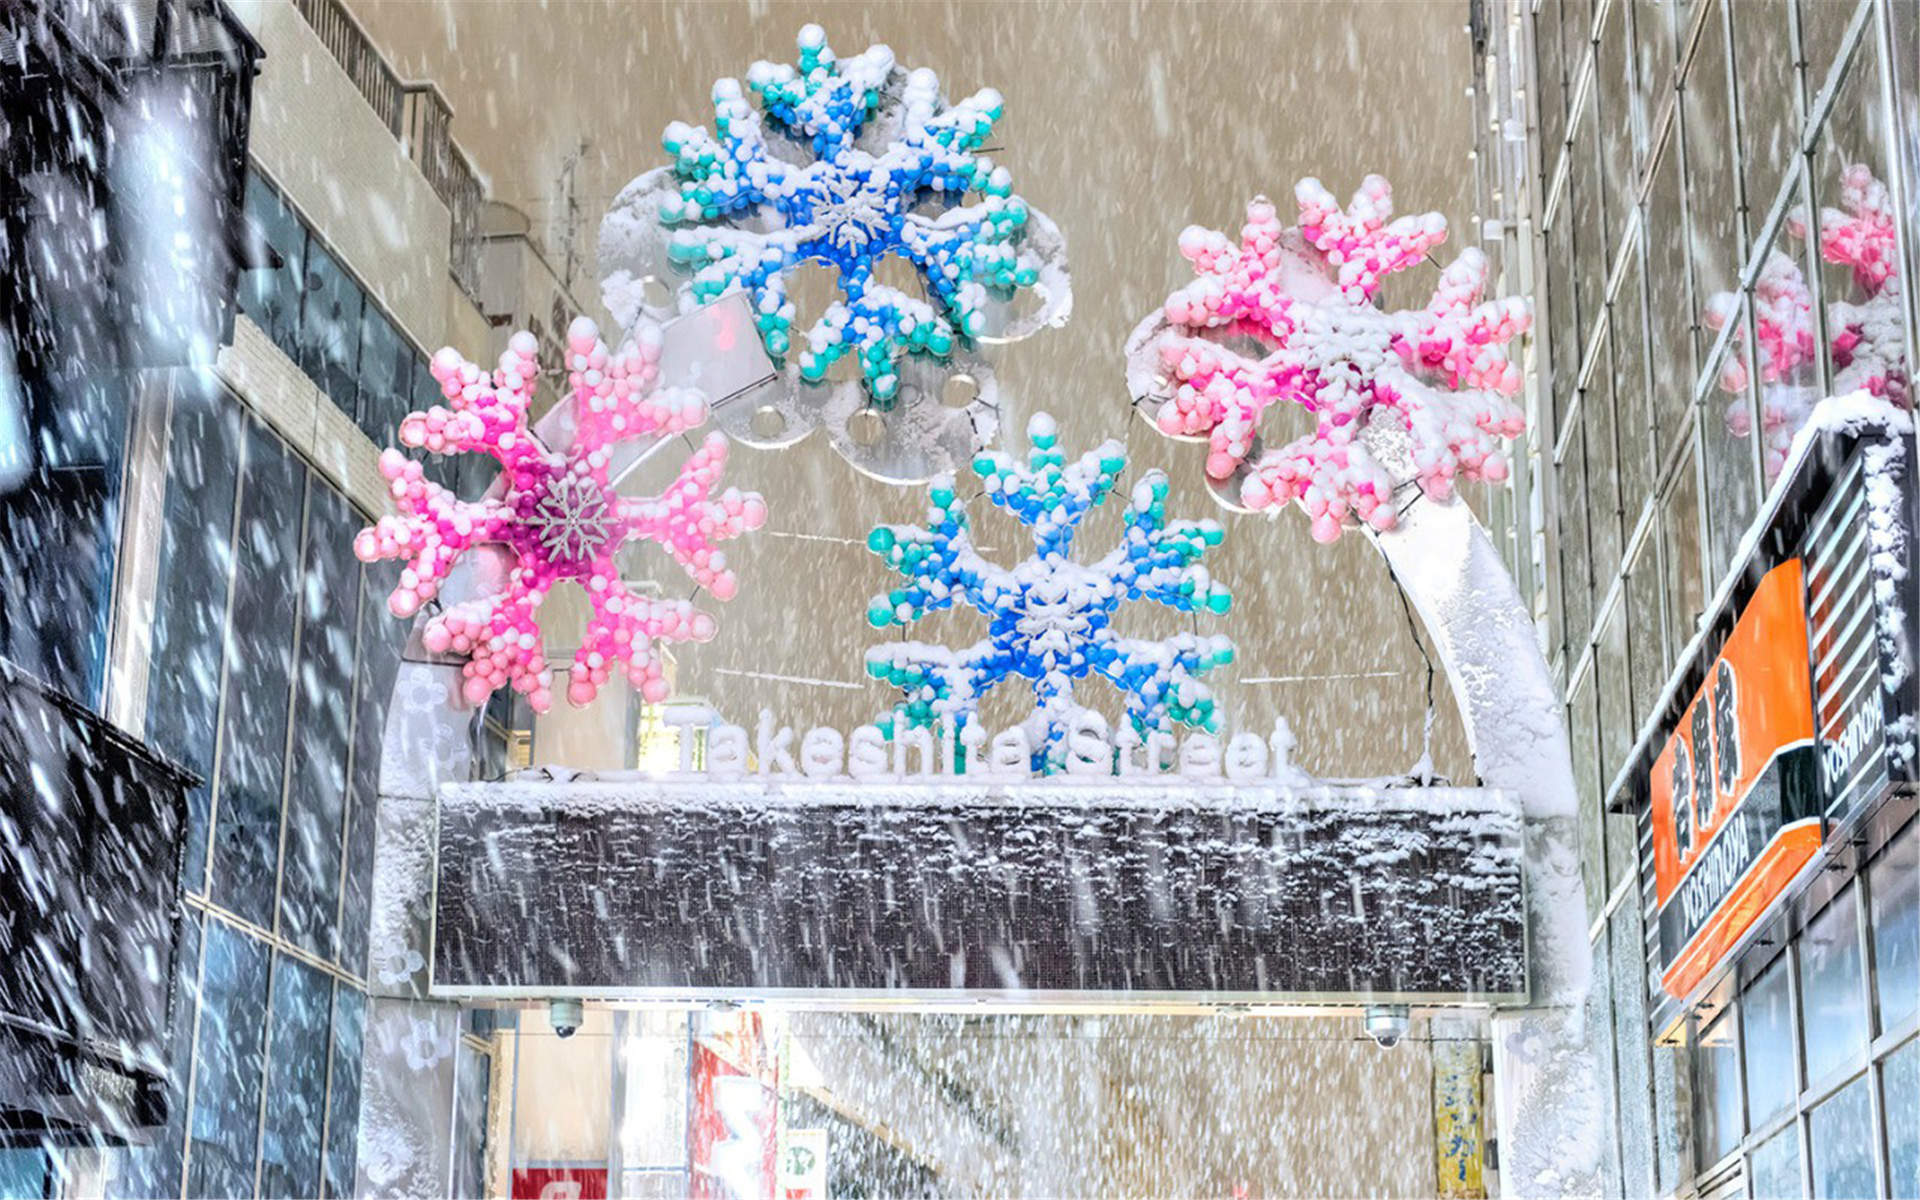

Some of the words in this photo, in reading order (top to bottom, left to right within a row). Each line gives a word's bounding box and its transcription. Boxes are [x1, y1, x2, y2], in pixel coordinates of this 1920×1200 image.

[663, 704, 1031, 777] Takeshita
[1066, 710, 1298, 777] Street
[1681, 810, 1750, 938] YOSHINOYA
